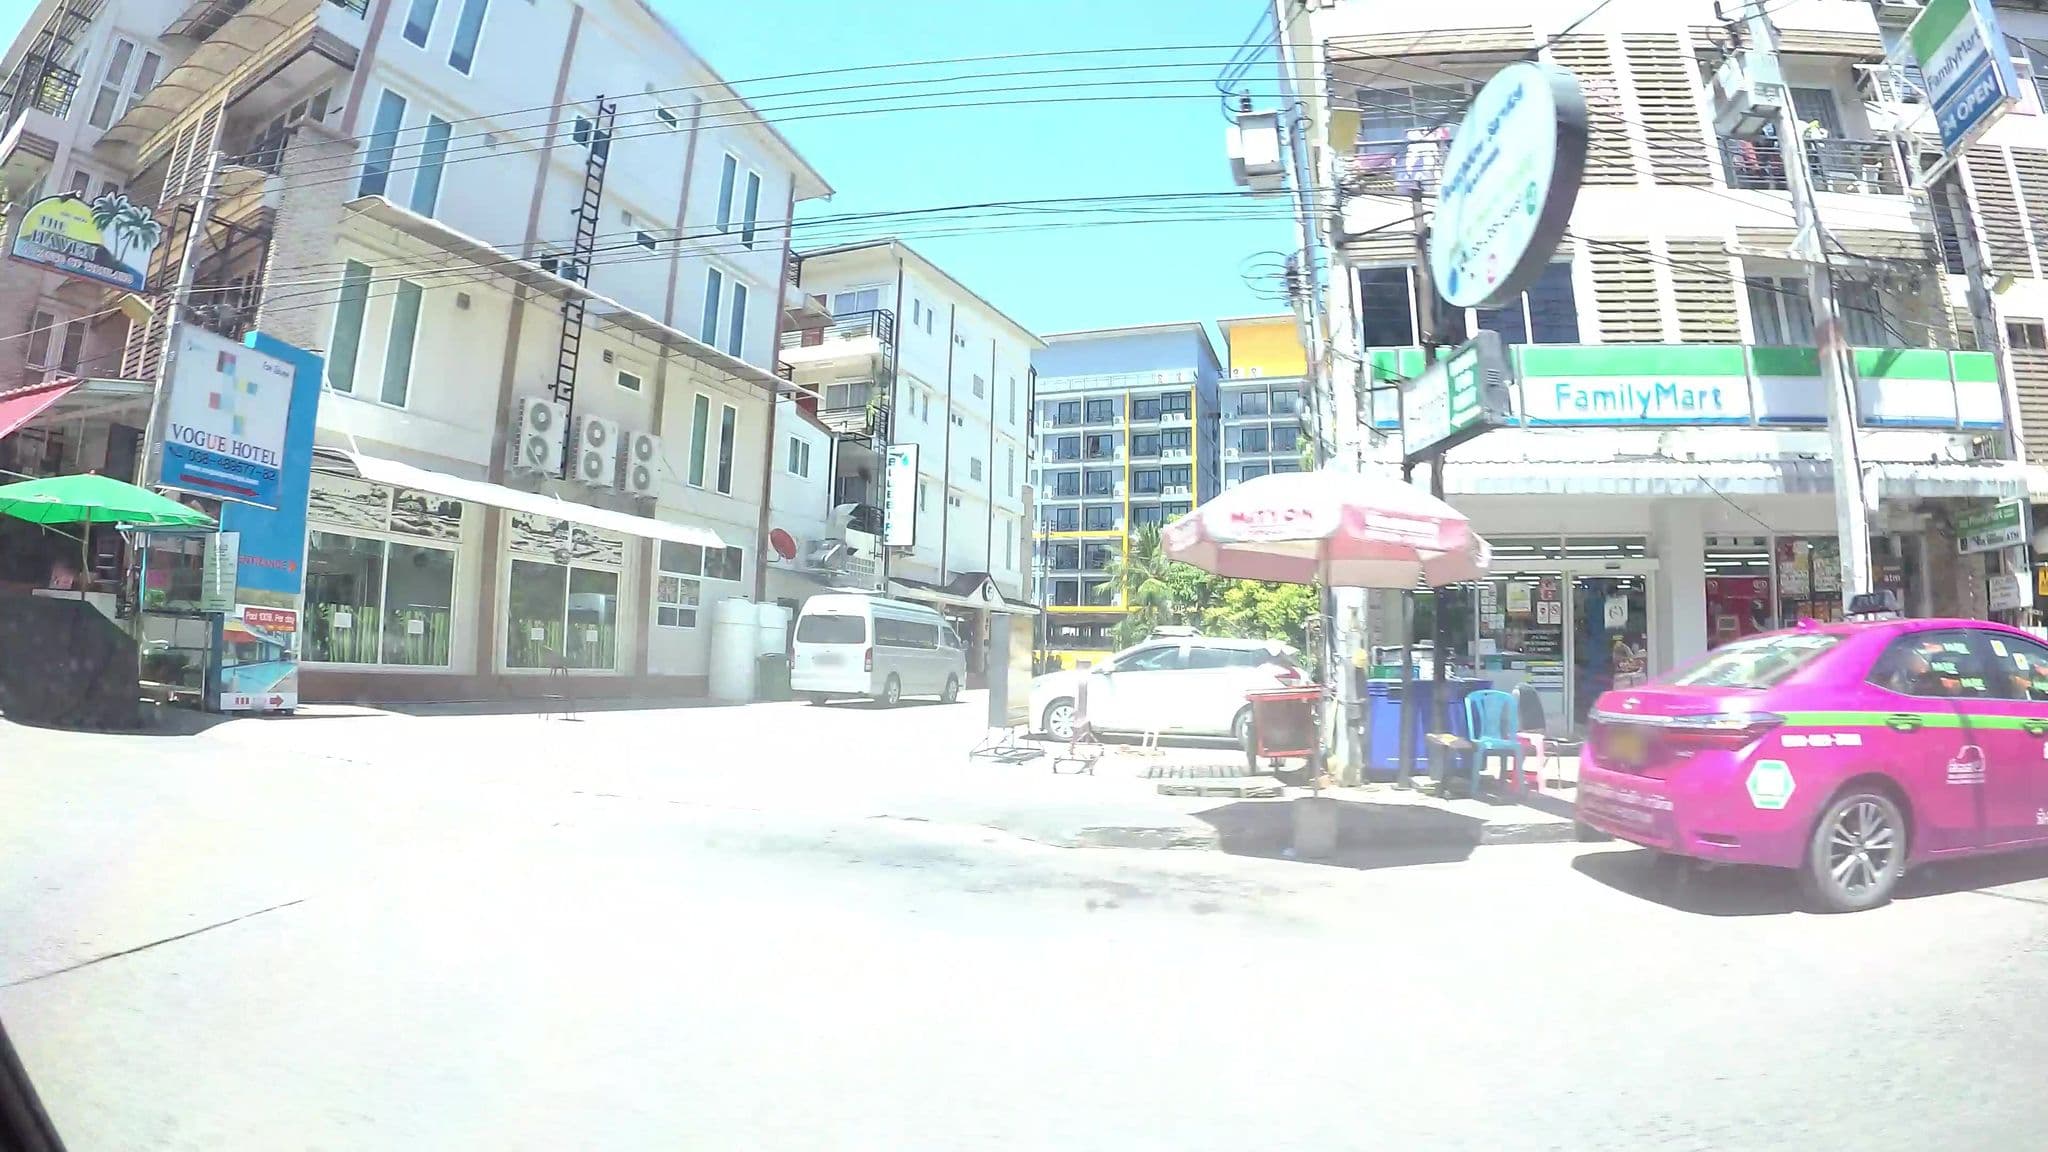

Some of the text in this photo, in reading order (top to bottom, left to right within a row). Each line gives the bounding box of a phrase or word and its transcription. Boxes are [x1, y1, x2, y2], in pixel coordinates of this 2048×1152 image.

[1928, 29, 1981, 90] FamilyMart
[1957, 76, 1995, 120] OPEN
[39, 214, 65, 231] THE
[31, 228, 97, 262] HAVEN
[1555, 383, 1723, 416] FamilyMart
[171, 423, 279, 467] VOGUE HOTEL
